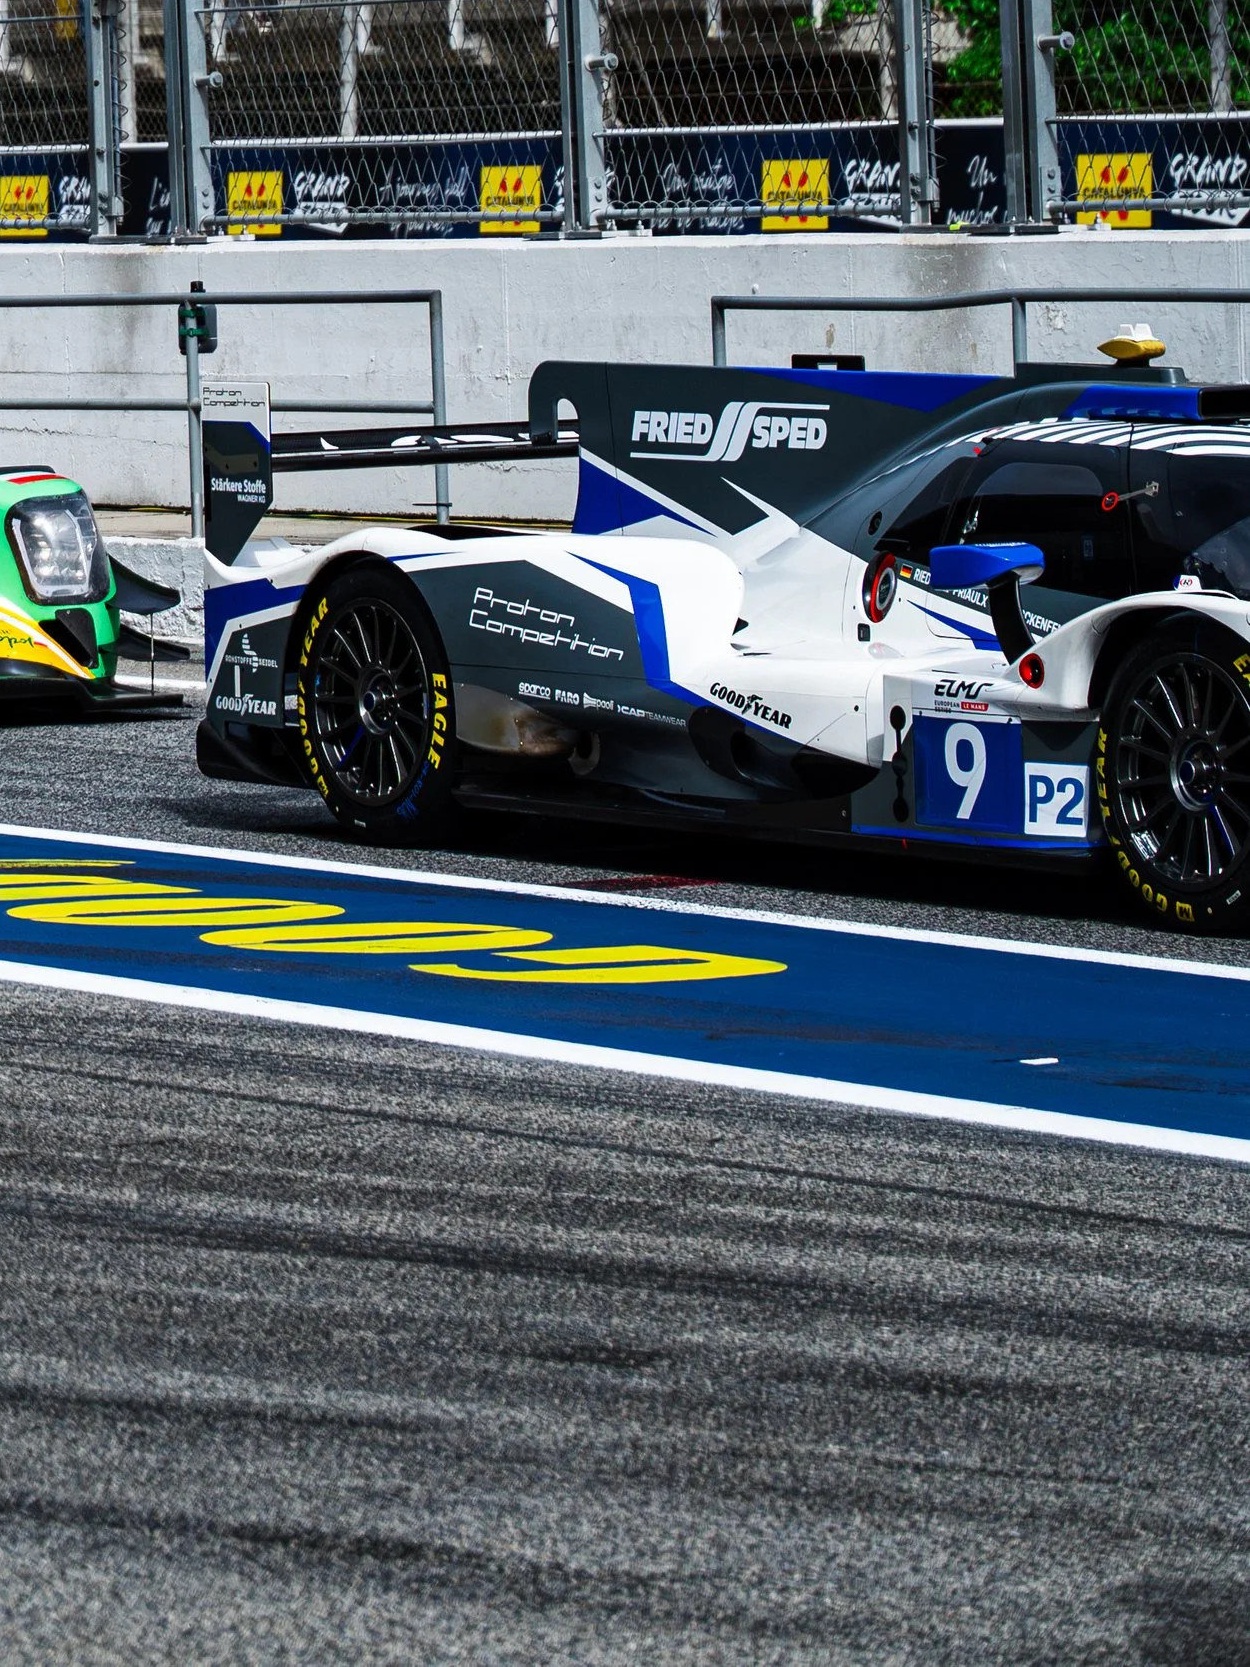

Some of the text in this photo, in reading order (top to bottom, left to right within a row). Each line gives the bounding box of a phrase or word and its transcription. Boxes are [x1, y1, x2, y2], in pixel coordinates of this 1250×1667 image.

[843, 159, 900, 194] GRAN
[1168, 153, 1248, 185] GRAND
[485, 195, 536, 207] CATALUNYA
[766, 190, 824, 202] CATALUNYA
[1083, 187, 1146, 199] CATALUNYA
[232, 199, 277, 211] CATALUNYA
[202, 386, 242, 396] Proton
[202, 397, 266, 408] Competition
[631, 410, 828, 450] FRIED SPED
[210, 477, 267, 494] Stärkere Stoffe
[473, 586, 575, 628] Proton
[468, 608, 625, 662] Competition
[225, 654, 279, 669] ROHSTOFFE SEIDEL
[297, 596, 329, 774] GOODYEAR
[518, 681, 551, 698] sparco
[215, 694, 277, 717] GOODYEAR
[555, 690, 580, 706] FARO
[709, 681, 793, 730] GOODYEAR
[934, 699, 960, 709] EUROPEAN
[970, 703, 985, 711] MANS
[427, 672, 449, 770] EAGLE
[944, 722, 987, 820] 9
[1029, 774, 1085, 826] P2
